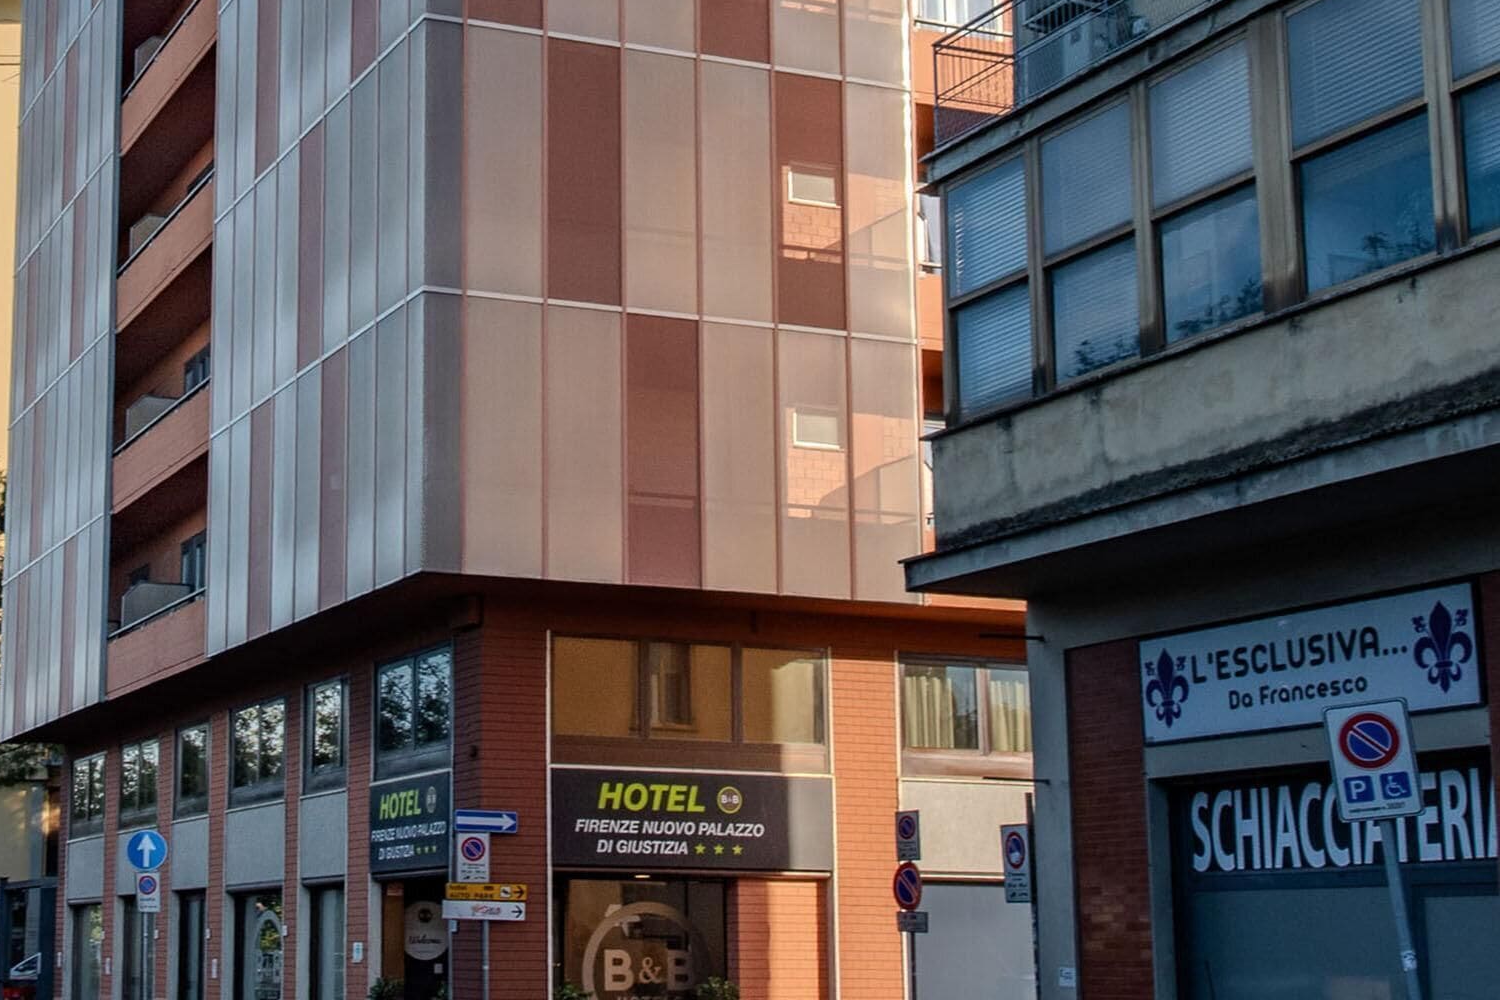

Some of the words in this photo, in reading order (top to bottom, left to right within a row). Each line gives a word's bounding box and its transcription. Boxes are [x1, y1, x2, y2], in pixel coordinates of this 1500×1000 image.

[1190, 626, 1407, 684] L'ESCLUSIVA...
[1259, 676, 1368, 705] Francesco
[379, 789, 421, 820] HOTEL
[598, 782, 706, 813] HOTEL
[1349, 780, 1366, 800] P
[575, 819, 640, 834] FIRENZE
[642, 820, 696, 836] NUOVO
[698, 822, 765, 838] PALAZZO
[596, 839, 614, 853] DI
[616, 840, 688, 855] GIUSTIZIA
[604, 949, 694, 991] B&B
